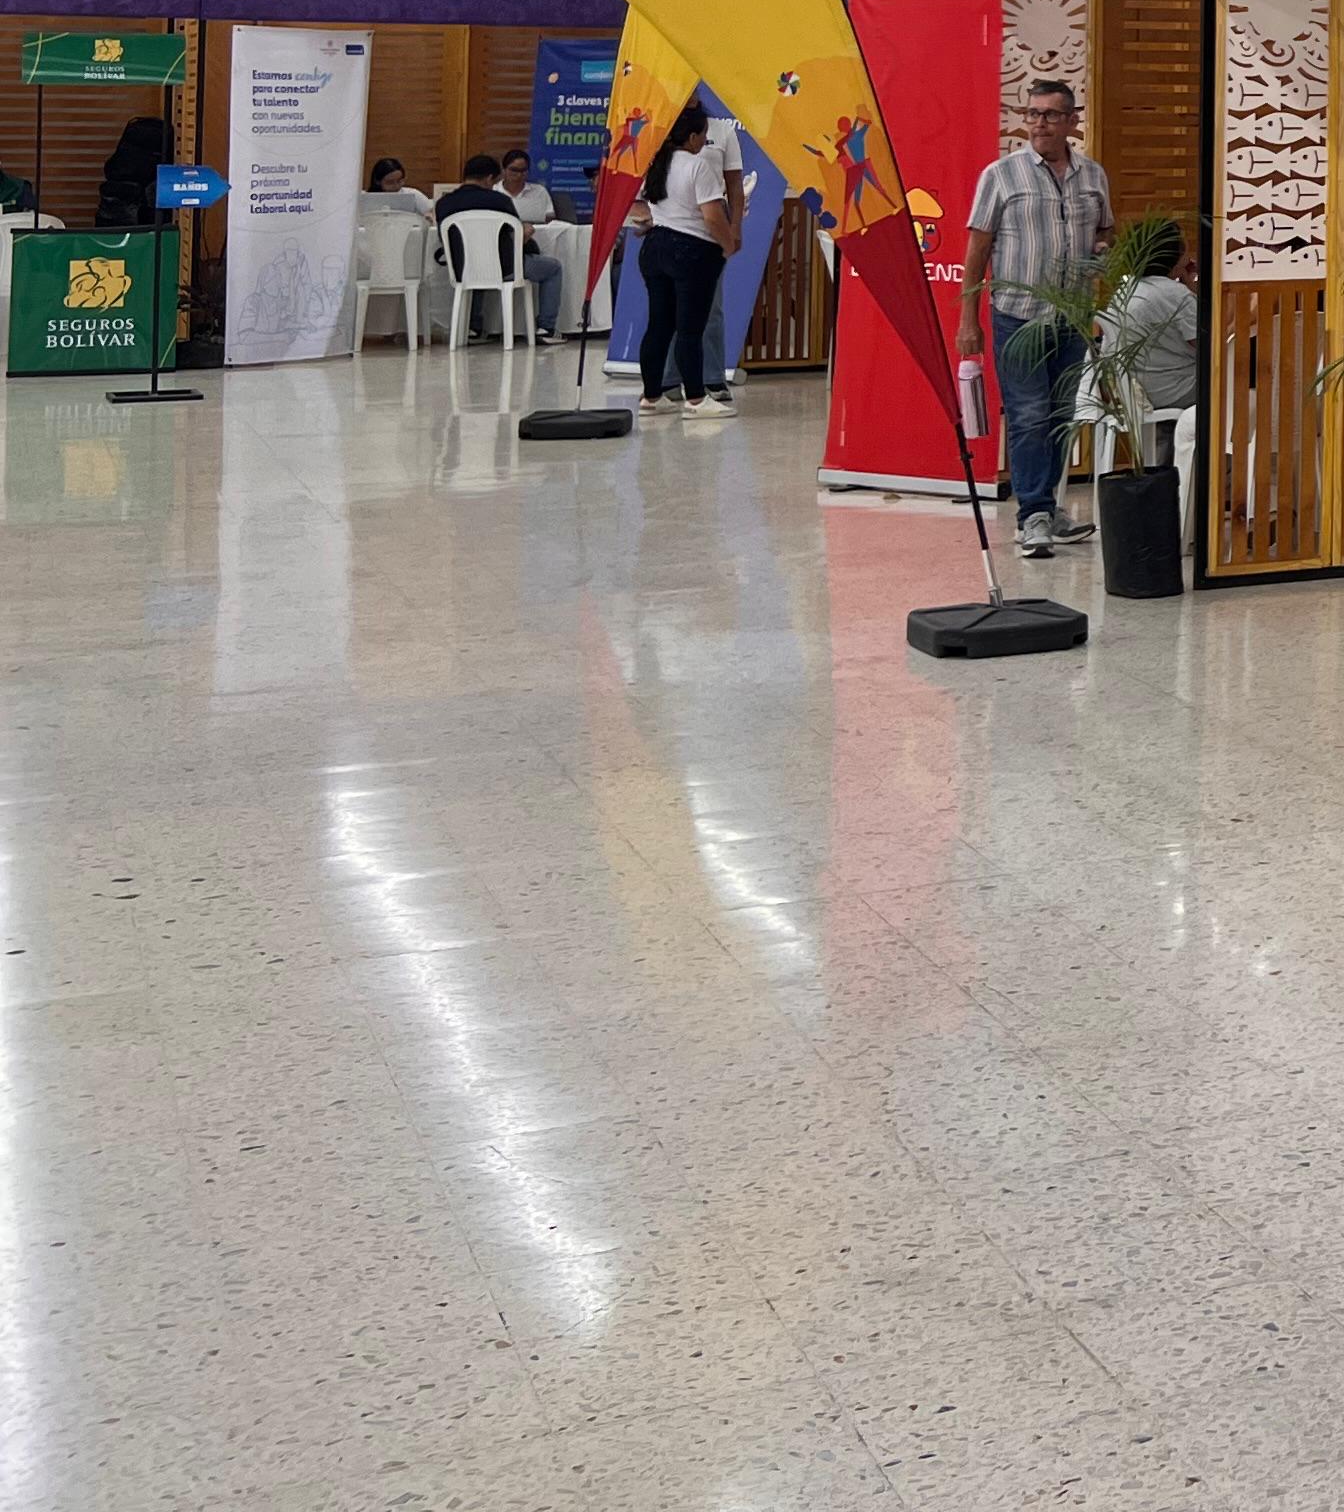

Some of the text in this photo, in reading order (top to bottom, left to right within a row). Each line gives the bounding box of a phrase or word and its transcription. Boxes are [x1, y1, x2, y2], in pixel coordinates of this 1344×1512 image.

[252, 69, 293, 81] Estamos
[252, 84, 320, 95] para conectar
[252, 97, 299, 107] tu talento
[566, 94, 603, 107] claves
[551, 108, 607, 126] biene
[544, 127, 605, 146] finan
[47, 317, 135, 332] SEGUROS
[46, 330, 136, 348] BOLÍVAR
